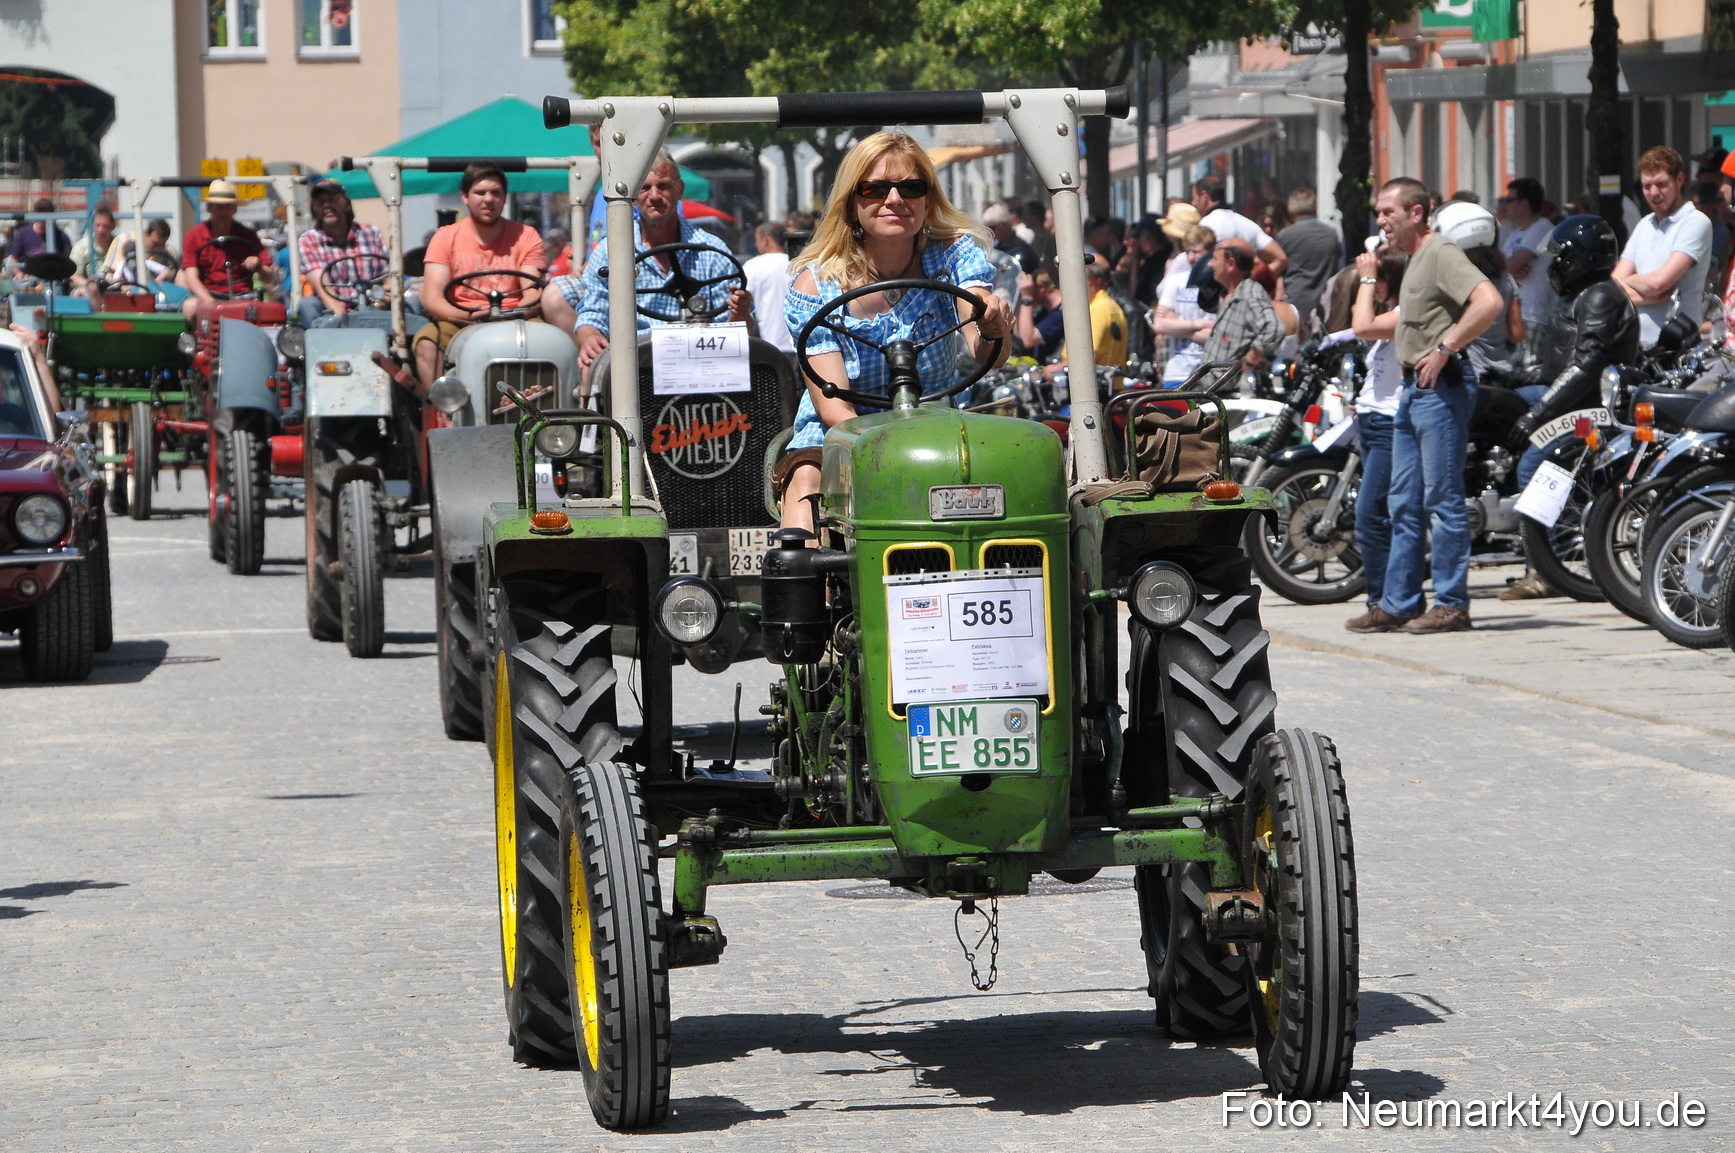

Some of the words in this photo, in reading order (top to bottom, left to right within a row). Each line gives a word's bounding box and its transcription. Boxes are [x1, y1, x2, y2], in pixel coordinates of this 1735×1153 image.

[695, 336, 727, 351] 447
[650, 413, 752, 453] Eicher
[669, 402, 733, 465] DIESEL
[1533, 472, 1559, 491] 276
[938, 486, 996, 516] Bautz
[962, 600, 1014, 627] 585
[916, 725, 925, 735] D
[936, 706, 979, 737] NM
[918, 739, 960, 771] EE
[973, 737, 1031, 767] 855
